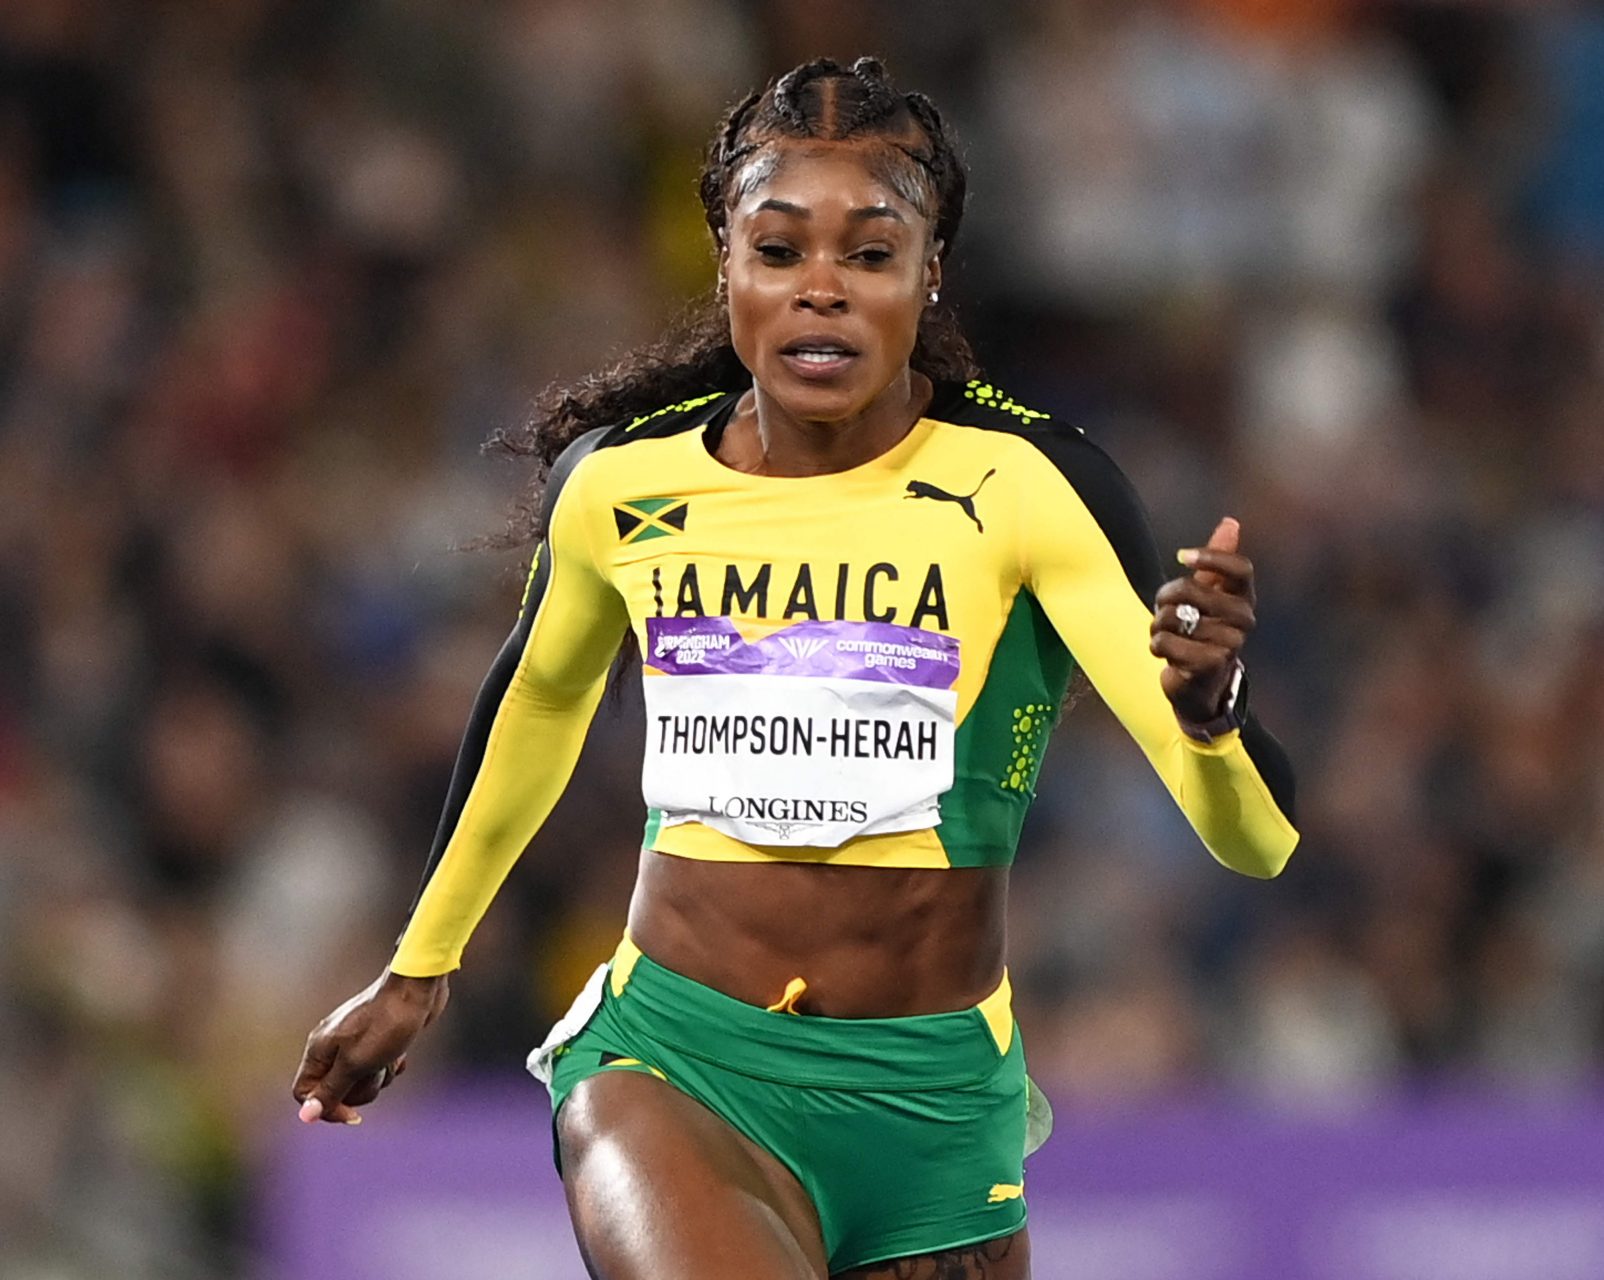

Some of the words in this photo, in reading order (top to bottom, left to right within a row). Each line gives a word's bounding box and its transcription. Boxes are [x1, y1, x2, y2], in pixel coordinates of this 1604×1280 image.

[676, 650, 706, 665] 2022
[865, 653, 917, 669] games
[657, 715, 937, 761] THOMPSON-HERAH
[709, 796, 868, 823] LONGINES
